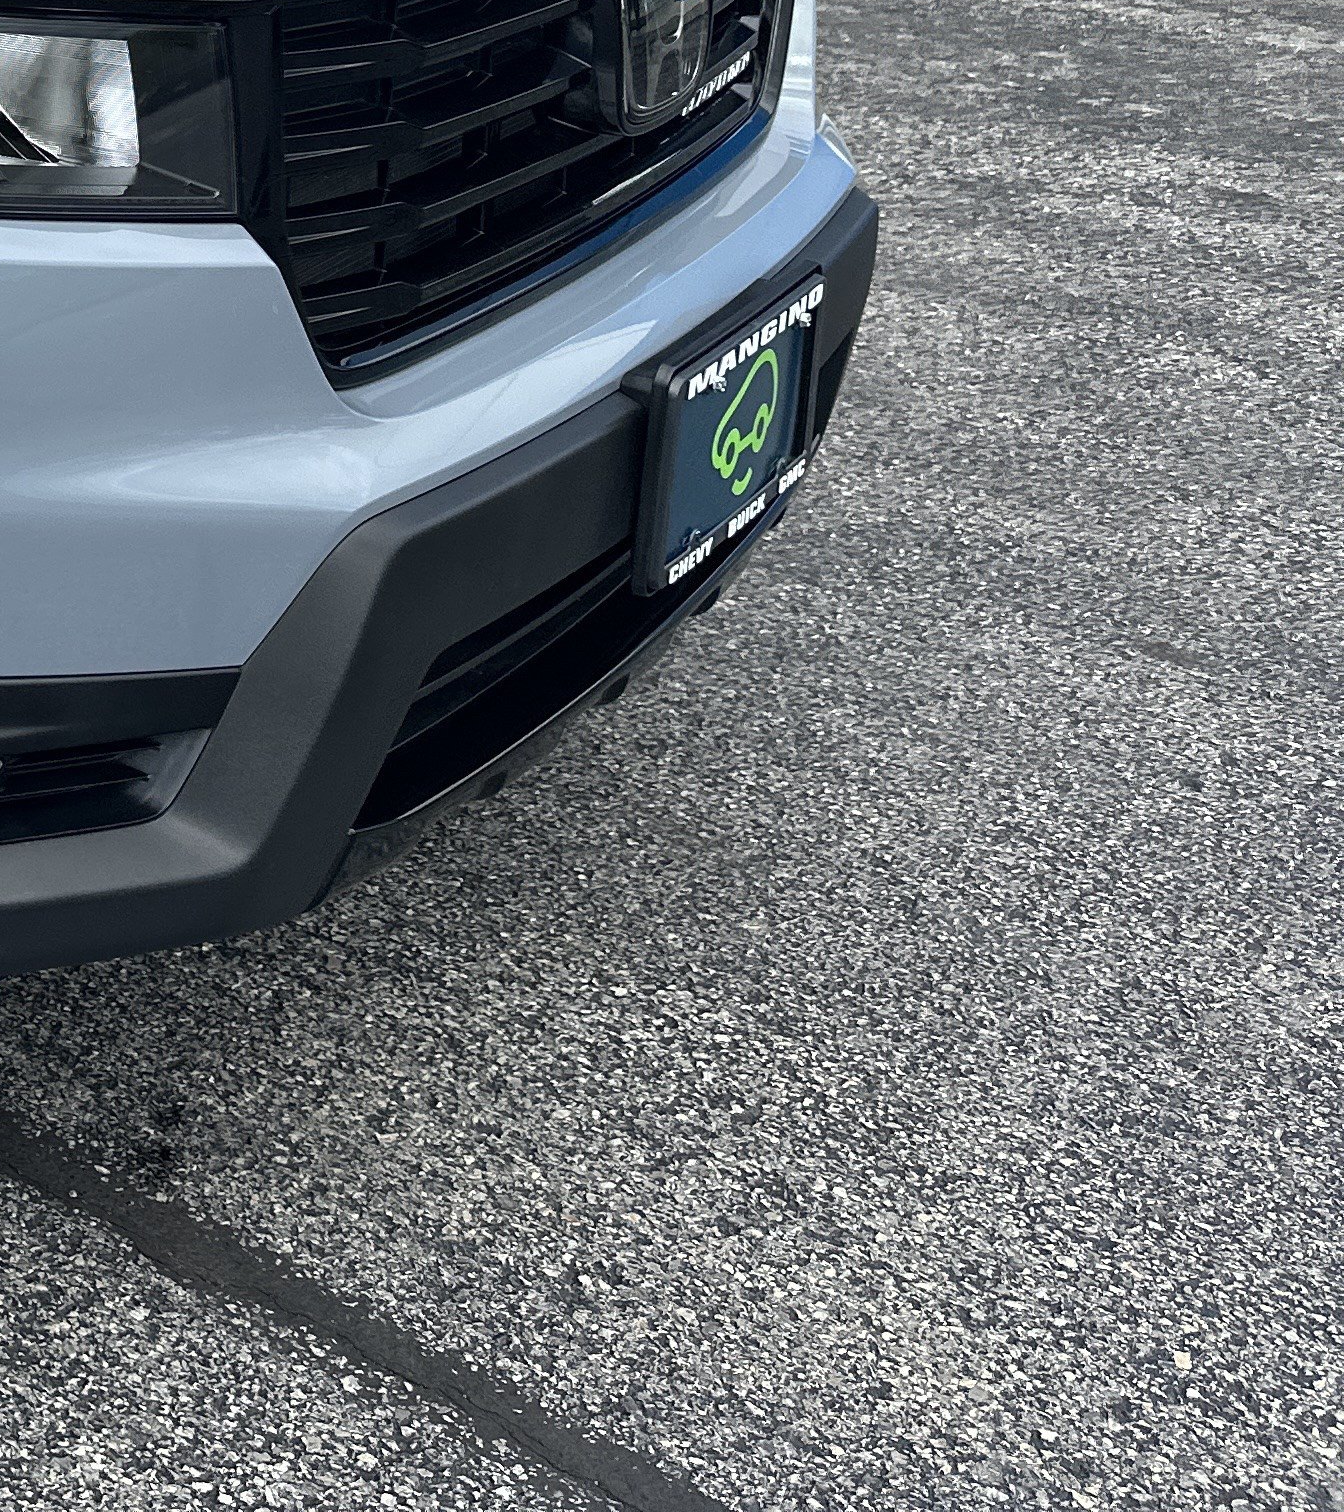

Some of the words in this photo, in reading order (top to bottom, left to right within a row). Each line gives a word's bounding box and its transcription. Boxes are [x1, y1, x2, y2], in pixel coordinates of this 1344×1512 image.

[687, 284, 824, 400] MANGINO
[668, 536, 714, 585] CHEVY
[727, 493, 767, 539] BUICK
[778, 458, 807, 495] GMC
